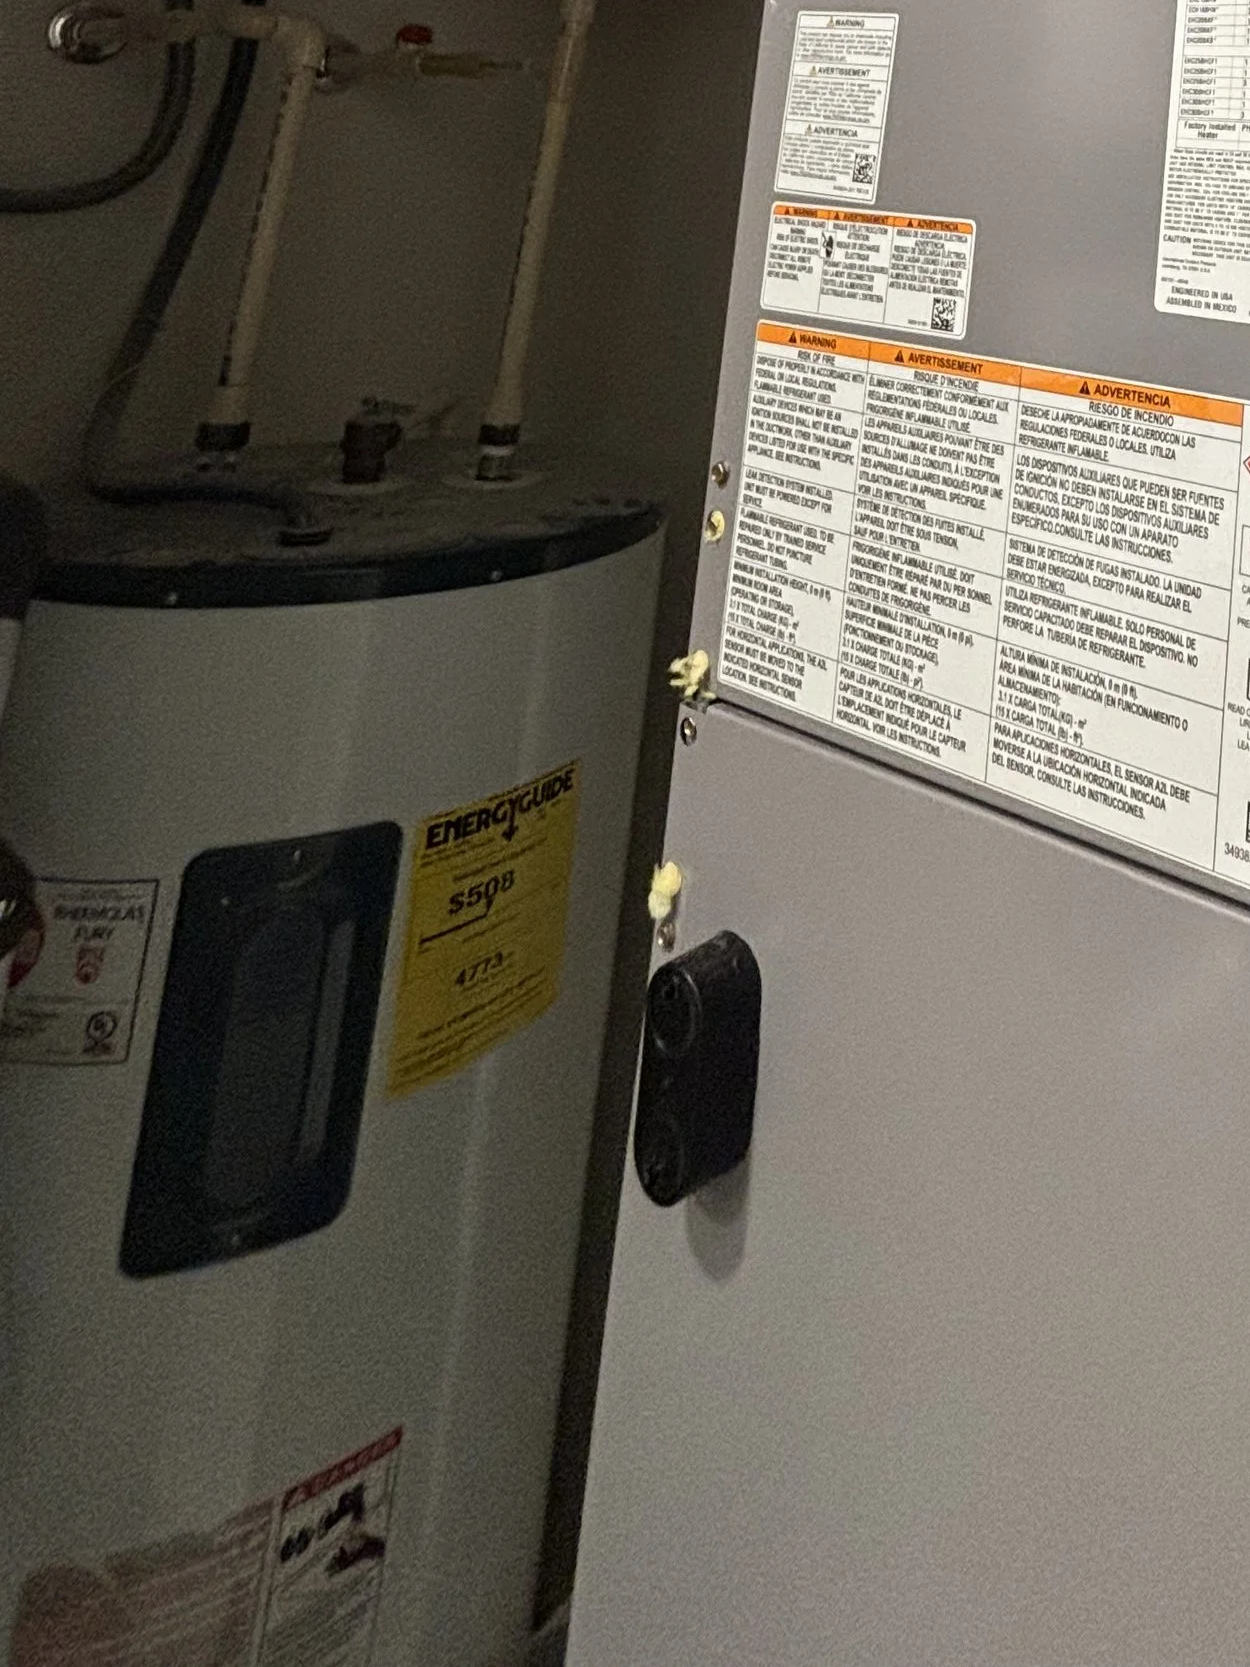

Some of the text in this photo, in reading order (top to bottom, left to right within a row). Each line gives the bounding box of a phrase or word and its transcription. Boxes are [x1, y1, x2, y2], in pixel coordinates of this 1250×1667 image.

[1166, 296, 1202, 308] ASSEMBLED
[1171, 285, 1209, 298] ENGINEERED
[799, 333, 836, 349] WARNING
[907, 352, 983, 375] AVERTISSEMENT
[914, 370, 978, 391] RISQUE D'INCENDIE
[1093, 384, 1170, 408] ADVERTENCIA
[1089, 400, 1174, 426] RIESGO DE INCENDIO
[1016, 453, 1224, 510] LOS DISPOSITIVOS AUXILIARES QUE PUEDEN SER FUENTES
[1015, 468, 1219, 526] DE IGNICIÓN NO DEBEN INSTALARSE EN EL SISTEMA DE
[1012, 497, 1178, 548] ENUMERADOS PARA SU USO CON UN APARATO
[1014, 482, 1208, 539] CONDUCTOS, EXCEPTO LOS DISPOSITIVOS AUXILIARES
